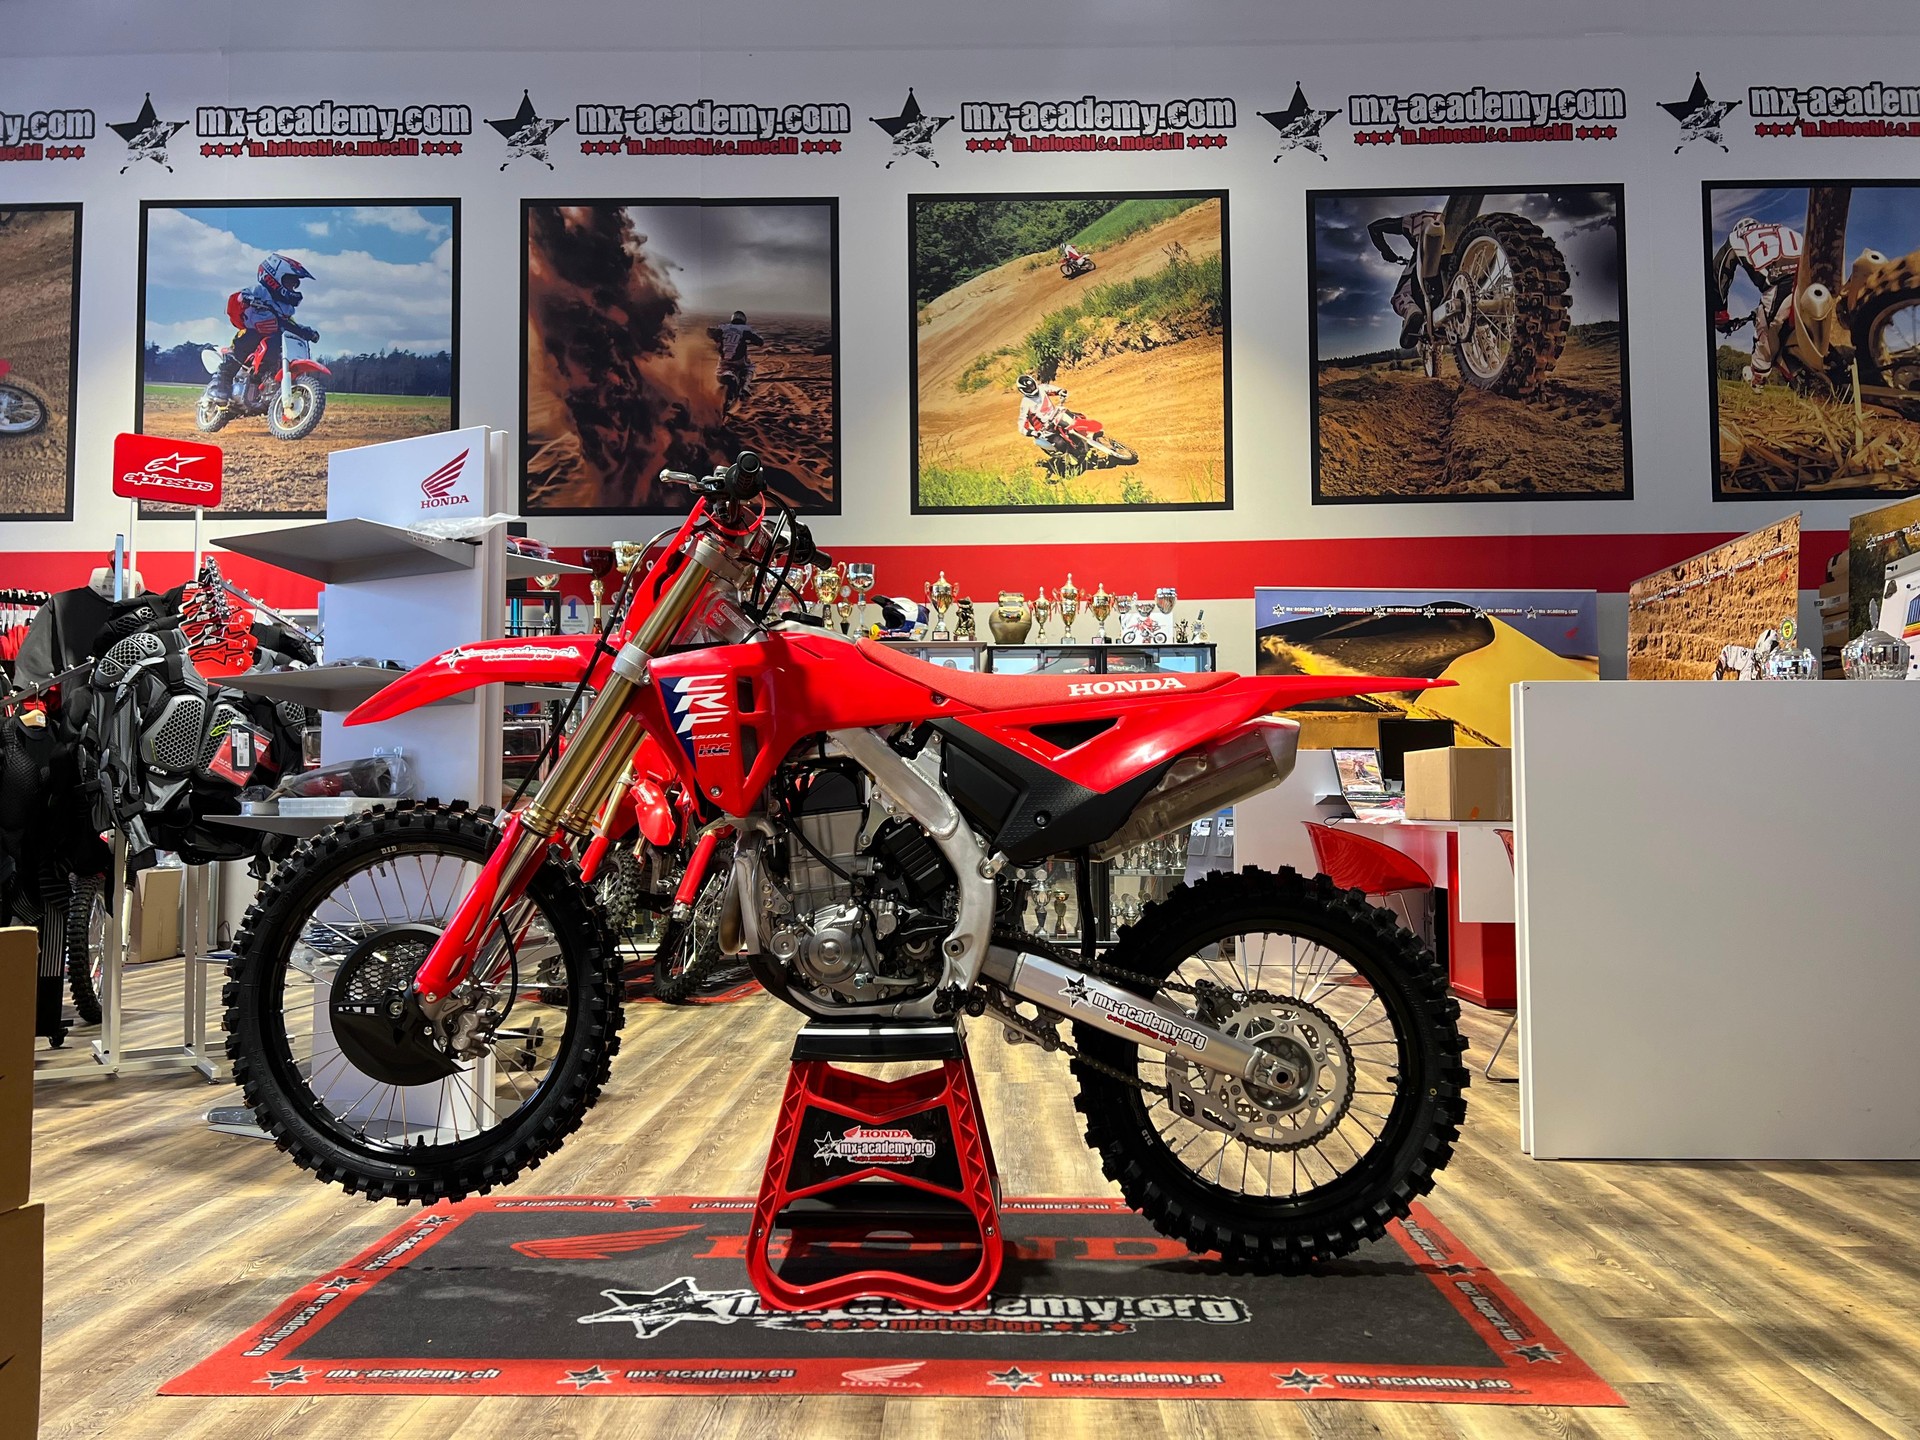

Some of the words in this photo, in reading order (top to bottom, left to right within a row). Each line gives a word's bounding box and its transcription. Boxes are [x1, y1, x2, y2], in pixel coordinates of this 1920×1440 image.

[1349, 86, 1626, 126] mx-academy.com
[197, 100, 472, 141] mx-academy.com
[577, 99, 850, 139] mx-academy.com
[961, 96, 1236, 135] mx-academy.com
[0, 109, 95, 147] y.com
[1746, 227, 1803, 270] 50
[421, 495, 469, 509] HONDA
[568, 598, 578, 619] 1
[1068, 677, 1186, 697] HONDA
[686, 732, 730, 740] 450R
[699, 743, 731, 755] HRC
[1092, 991, 1206, 1051] mx-academy.org
[860, 1130, 911, 1138] HONDA
[840, 1140, 934, 1156] mx-academy.org
[241, 1292, 341, 1357] mx-academy.org
[890, 1317, 1041, 1332] motoshop
[323, 1367, 502, 1380] mx-academy.ch
[624, 1368, 797, 1381] mx-academy.eu
[1050, 1372, 1225, 1385] mx-academy.at
[1334, 1373, 1513, 1390] mx-academy.ae
[840, 1381, 923, 1389] HONDA
